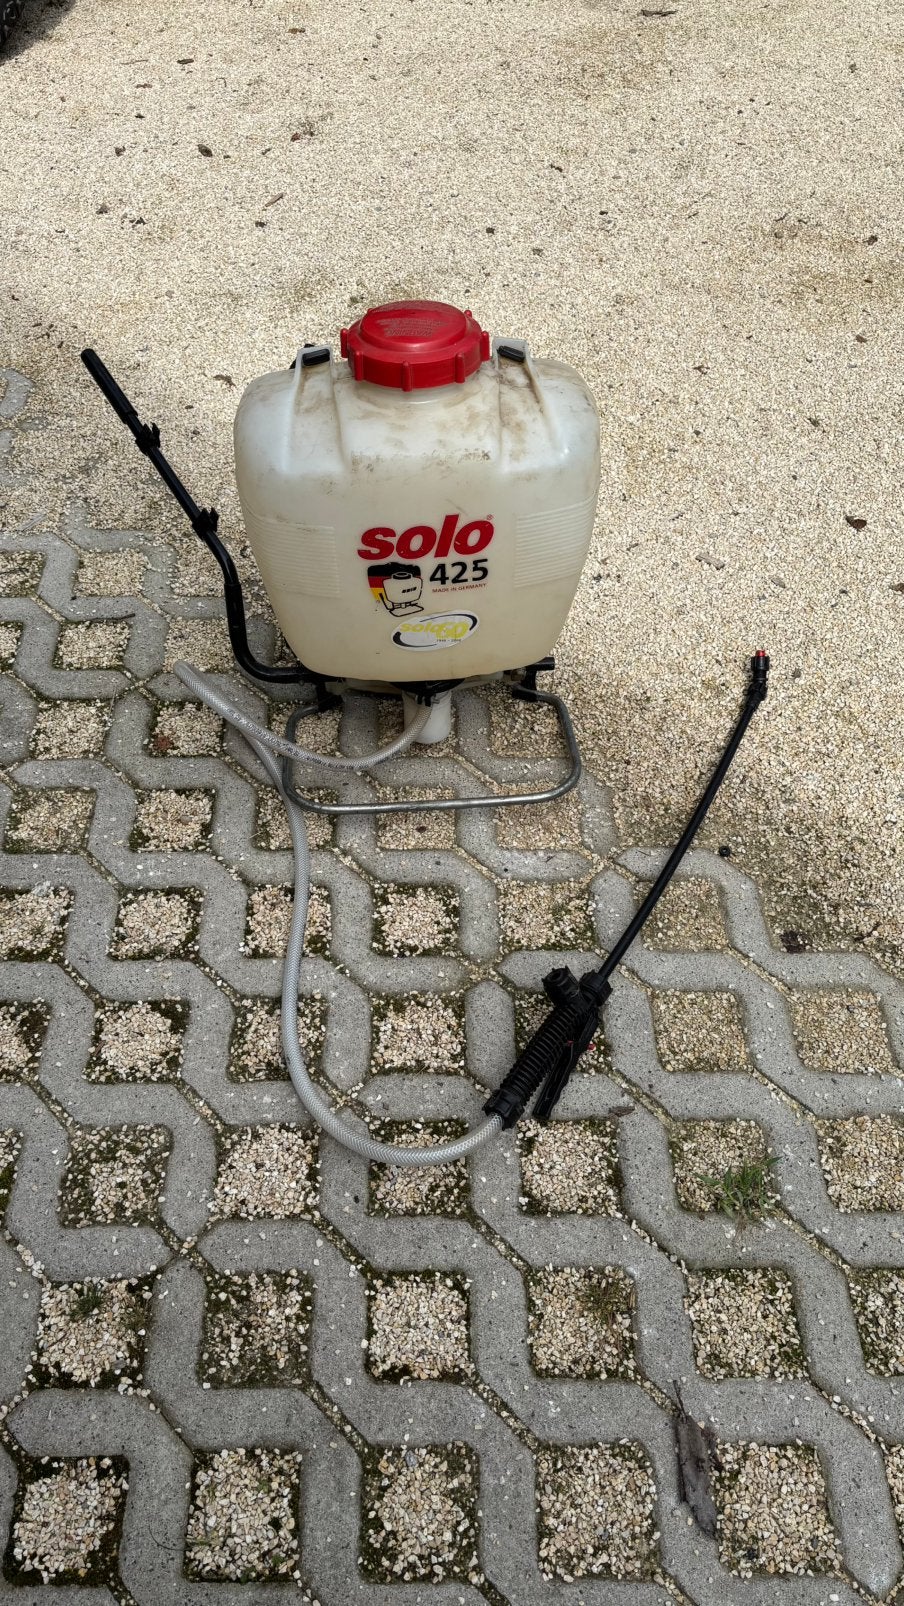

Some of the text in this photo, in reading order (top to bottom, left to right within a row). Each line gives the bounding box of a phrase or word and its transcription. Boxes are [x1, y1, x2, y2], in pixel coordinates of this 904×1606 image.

[357, 514, 494, 560] solo
[429, 558, 488, 585] 425
[458, 583, 486, 591] GERMANY
